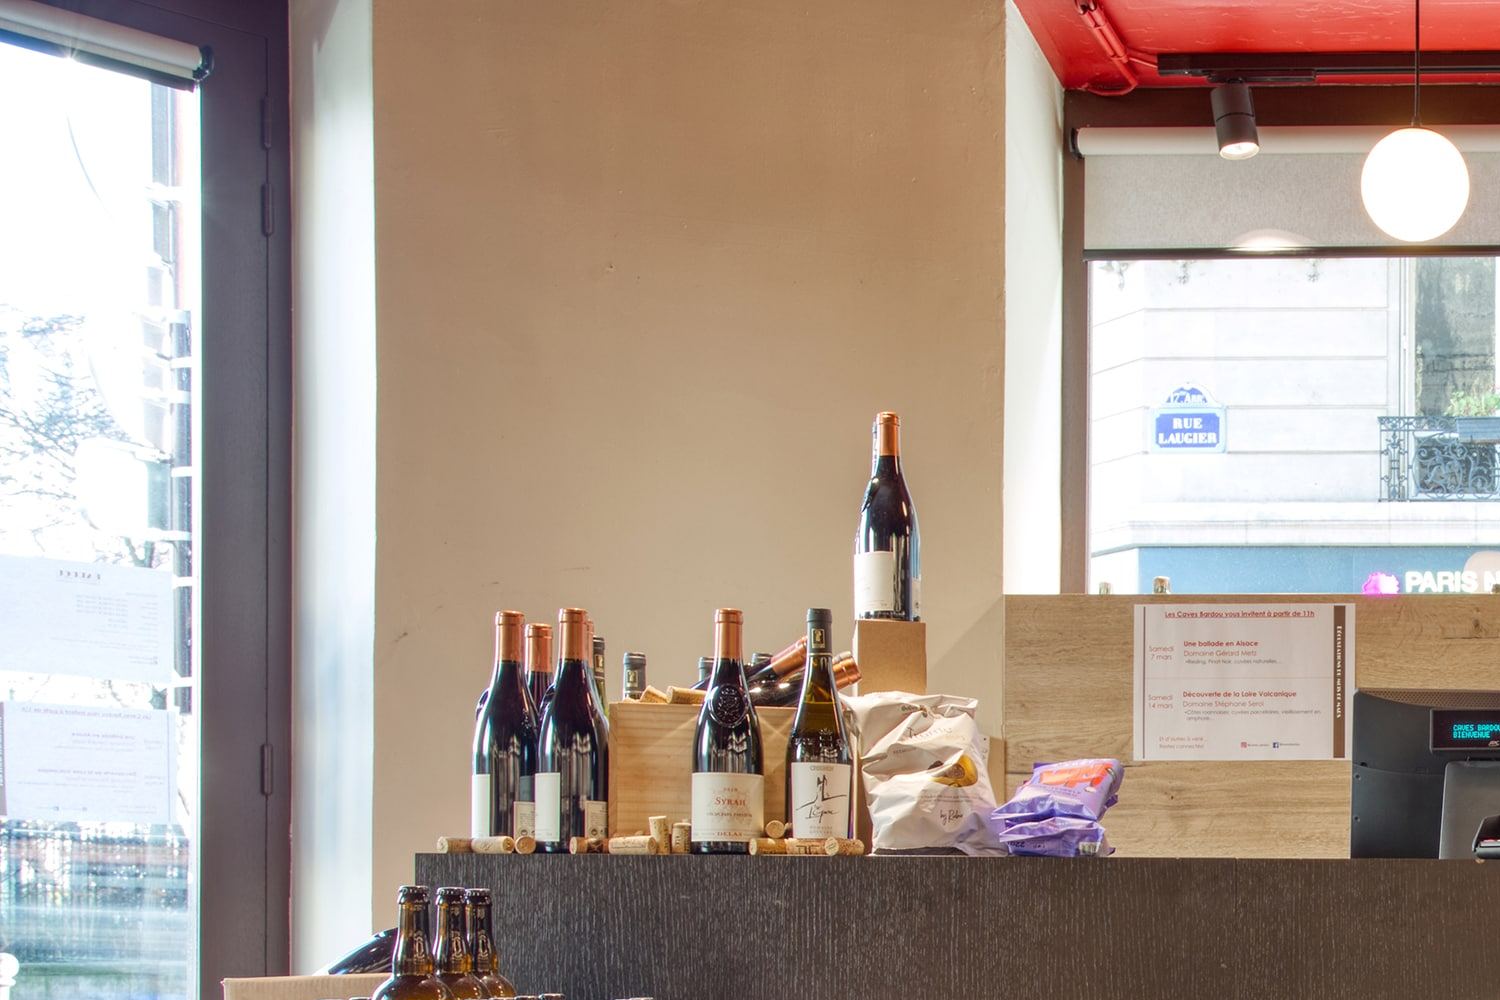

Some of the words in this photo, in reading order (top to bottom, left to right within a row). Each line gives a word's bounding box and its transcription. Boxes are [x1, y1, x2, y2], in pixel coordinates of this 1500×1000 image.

[1173, 418, 1202, 429] RUE
[1158, 433, 1217, 444] LAUGIER
[1405, 571, 1478, 593] PARIS
[716, 798, 745, 807] SYRAH
